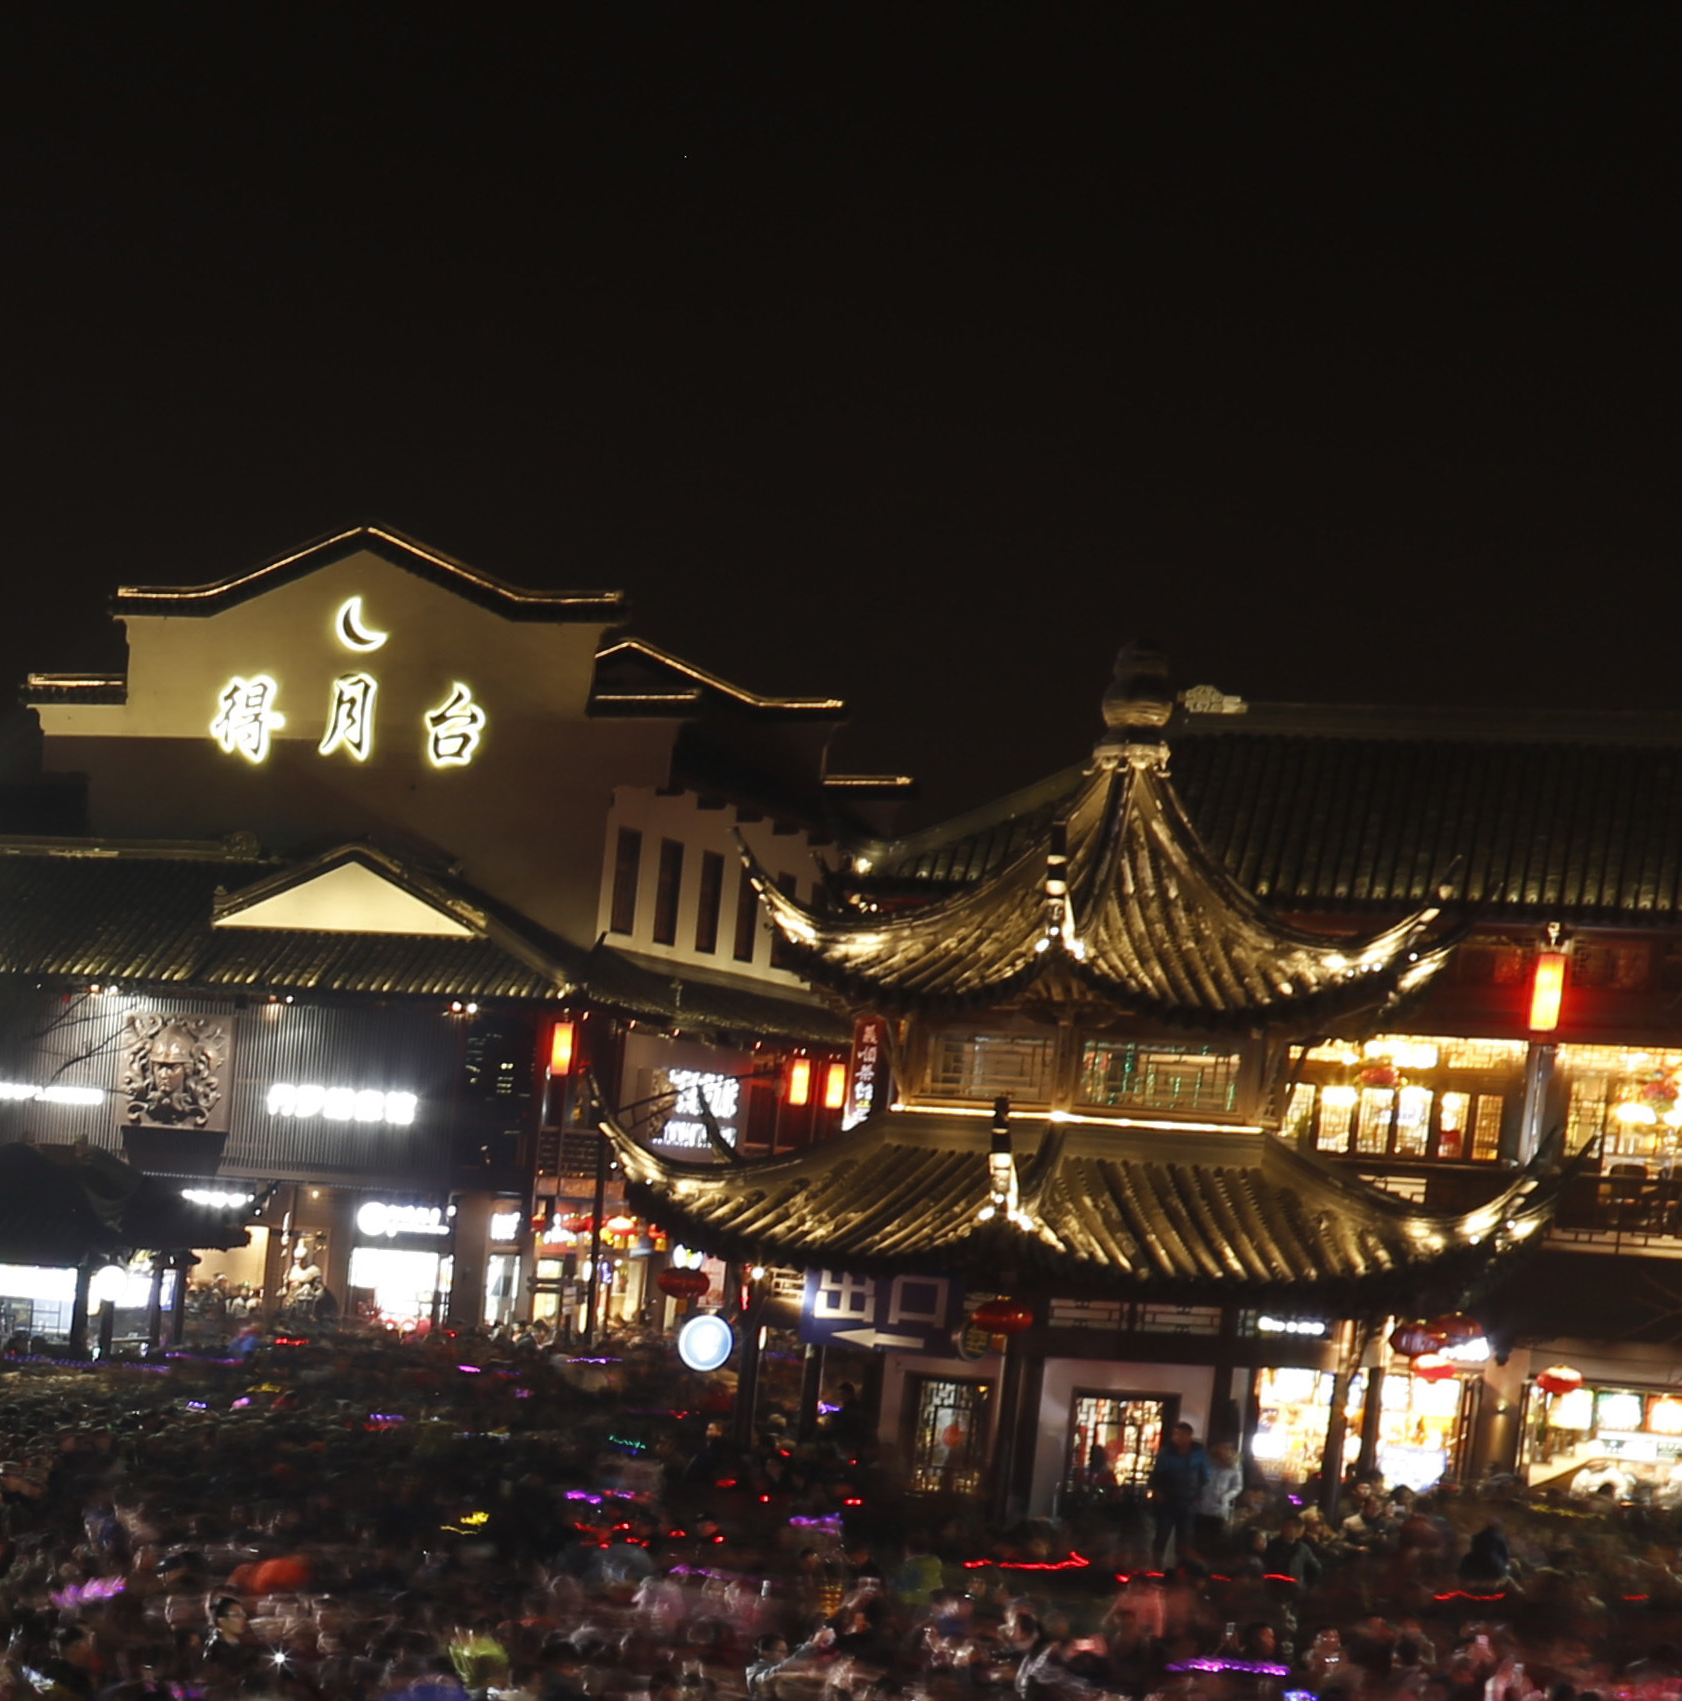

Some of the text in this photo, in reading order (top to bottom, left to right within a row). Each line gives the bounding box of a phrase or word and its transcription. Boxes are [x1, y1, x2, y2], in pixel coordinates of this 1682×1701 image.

[210, 672, 486, 768] 得月台
[814, 1268, 951, 1330] 出口
